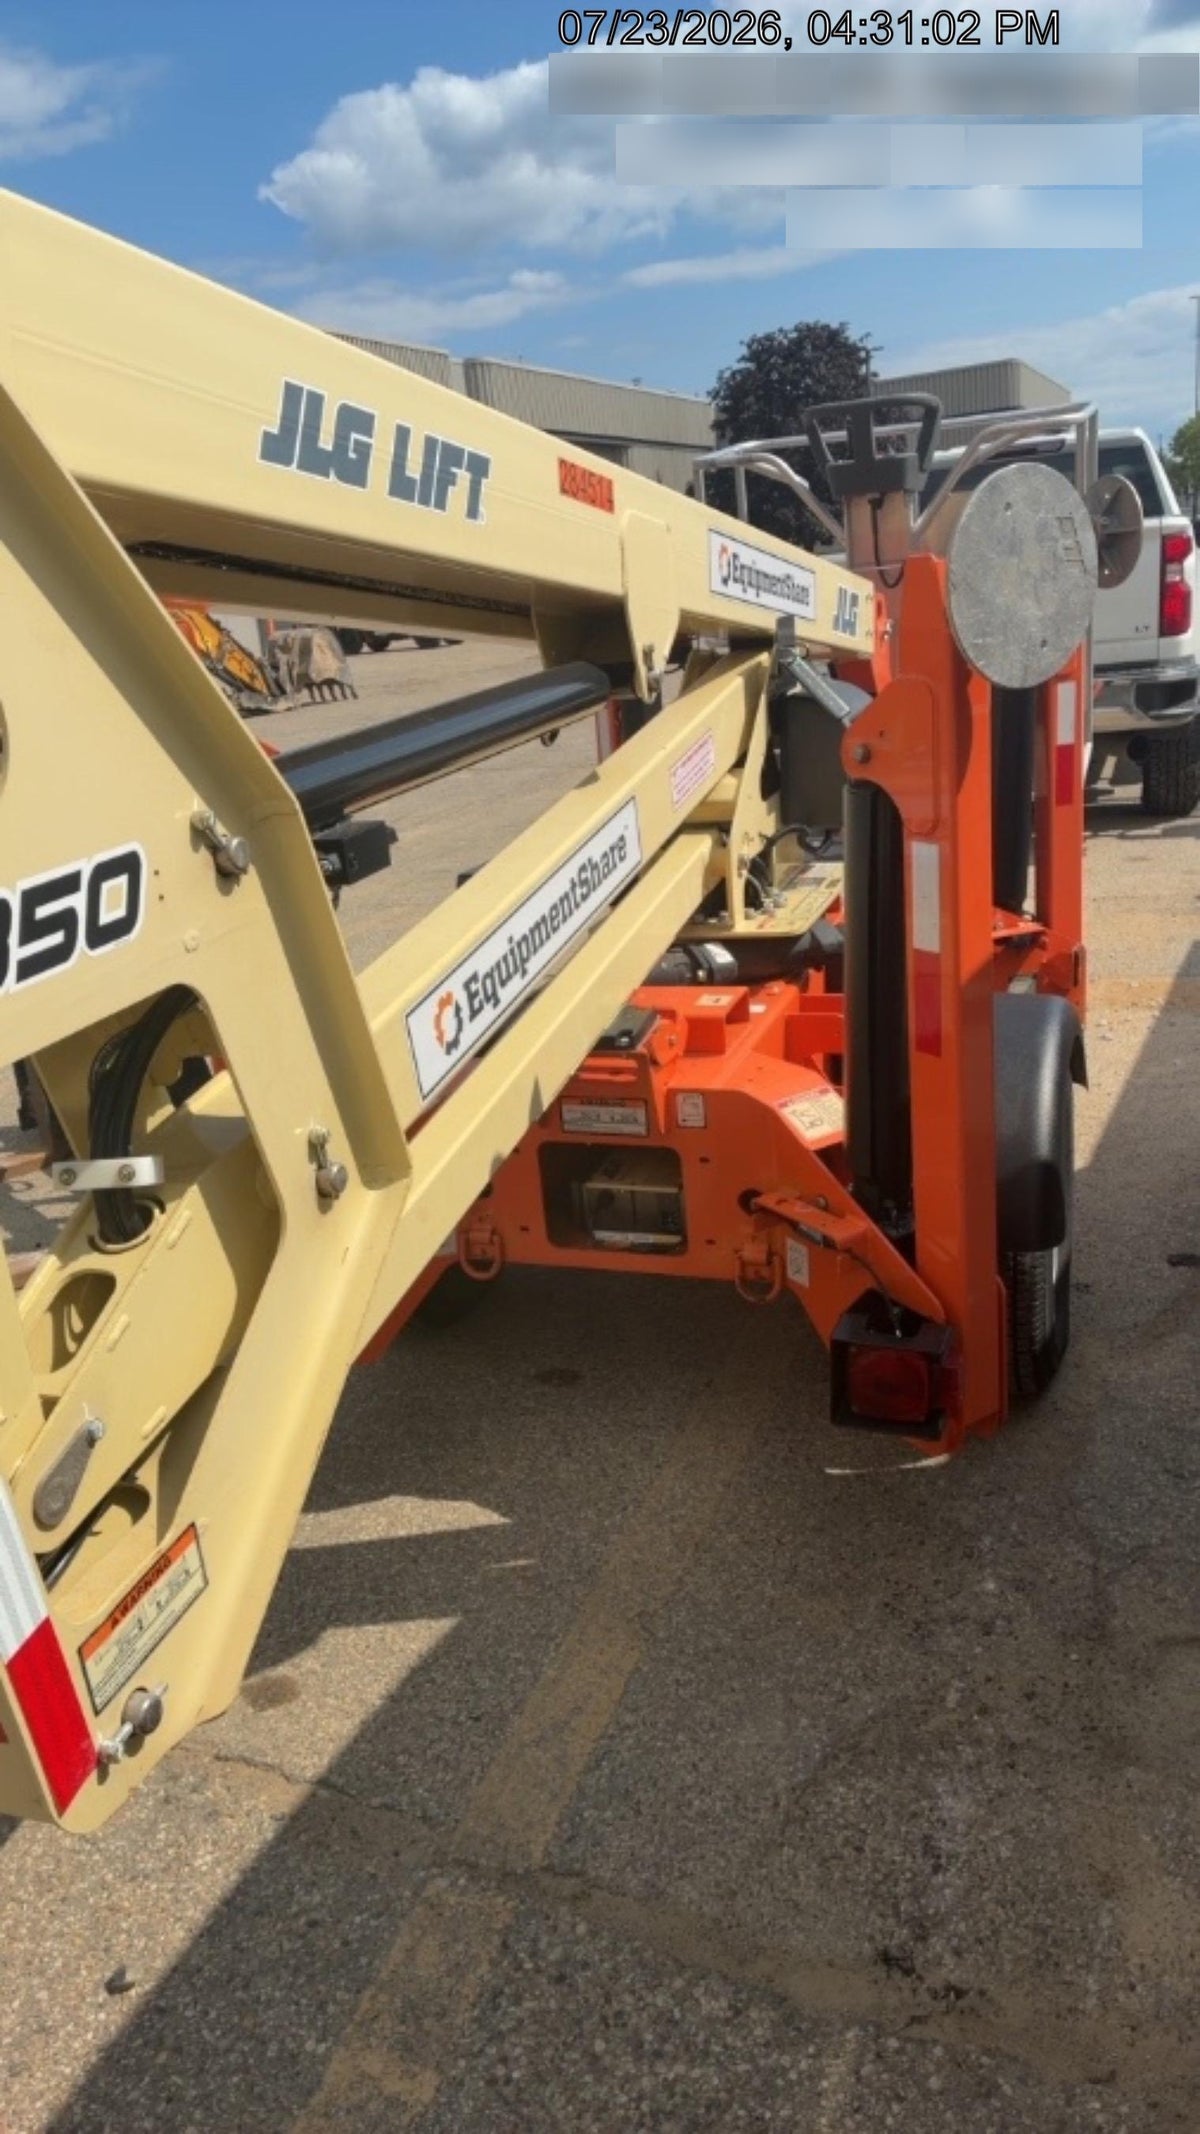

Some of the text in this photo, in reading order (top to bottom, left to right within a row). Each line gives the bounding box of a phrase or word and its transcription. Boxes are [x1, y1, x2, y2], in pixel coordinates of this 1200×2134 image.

[258, 379, 491, 522] JLG LIFT
[732, 551, 810, 607] EquipmentShare
[832, 584, 860, 638] JLG
[0, 848, 143, 987] 50
[462, 833, 627, 1023] EquipmentShare
